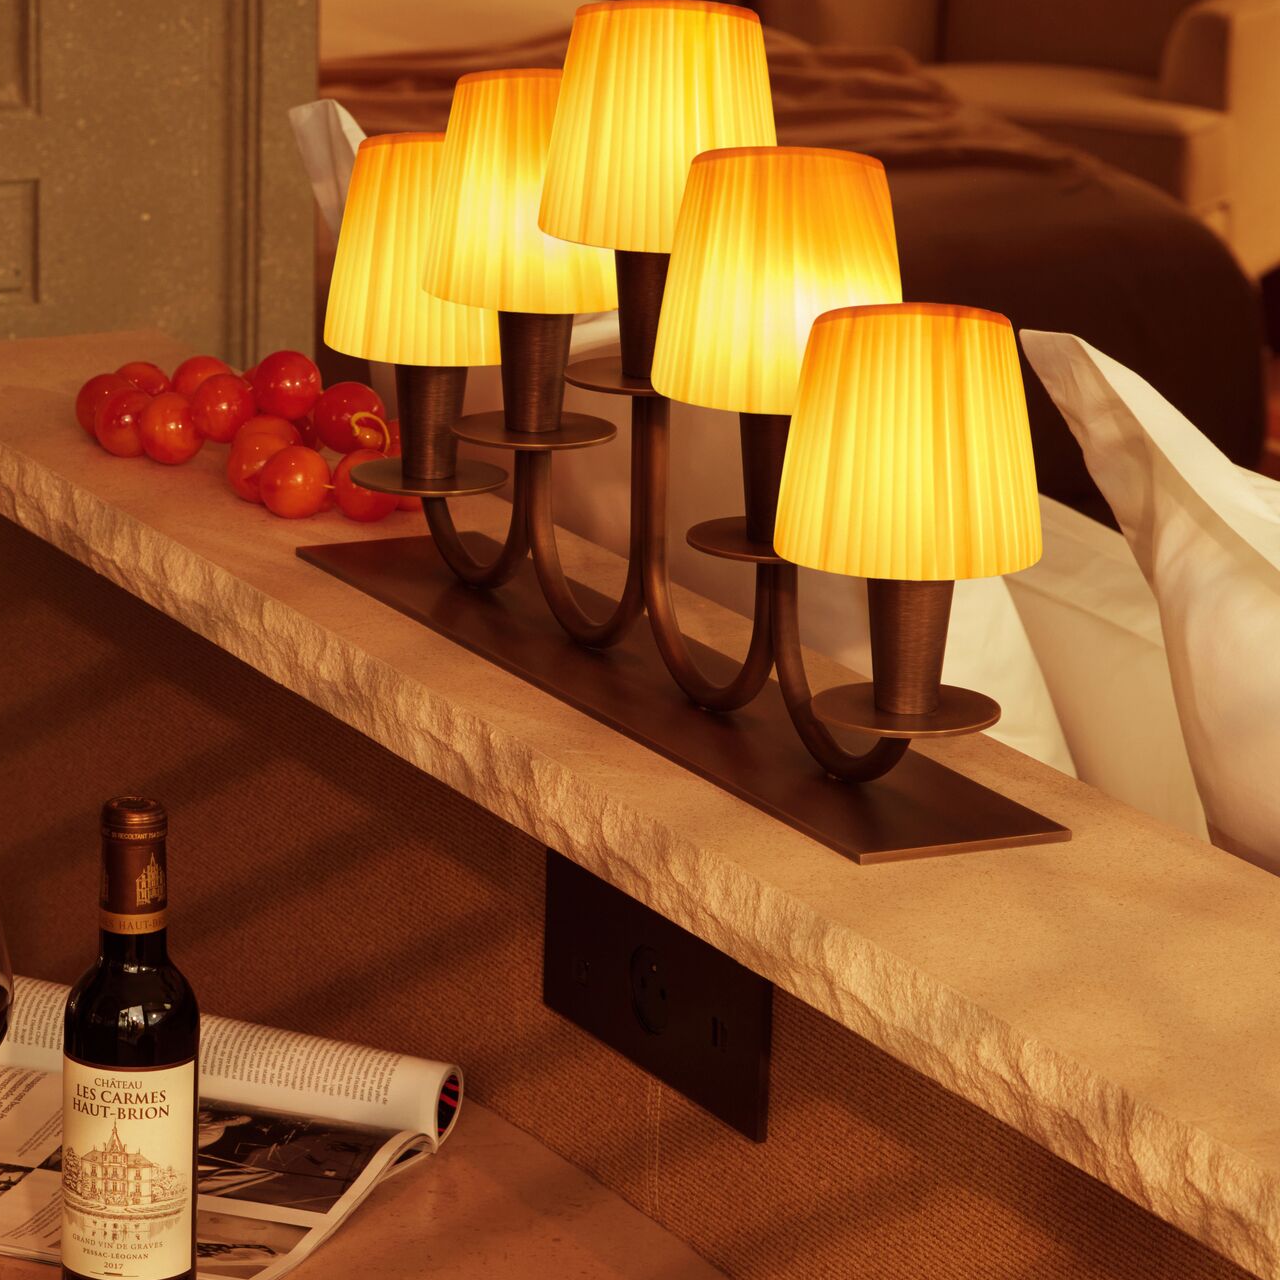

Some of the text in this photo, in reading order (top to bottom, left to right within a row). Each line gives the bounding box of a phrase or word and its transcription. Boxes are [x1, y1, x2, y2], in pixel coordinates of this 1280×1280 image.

[76, 1083, 167, 1105] LES CARMES
[73, 1097, 170, 1120] HAUT-BRION
[72, 1233, 96, 1247] GRAND
[98, 1240, 114, 1250] VIN
[130, 1241, 164, 1251] GRAVES
[103, 1261, 124, 1270] 2017
